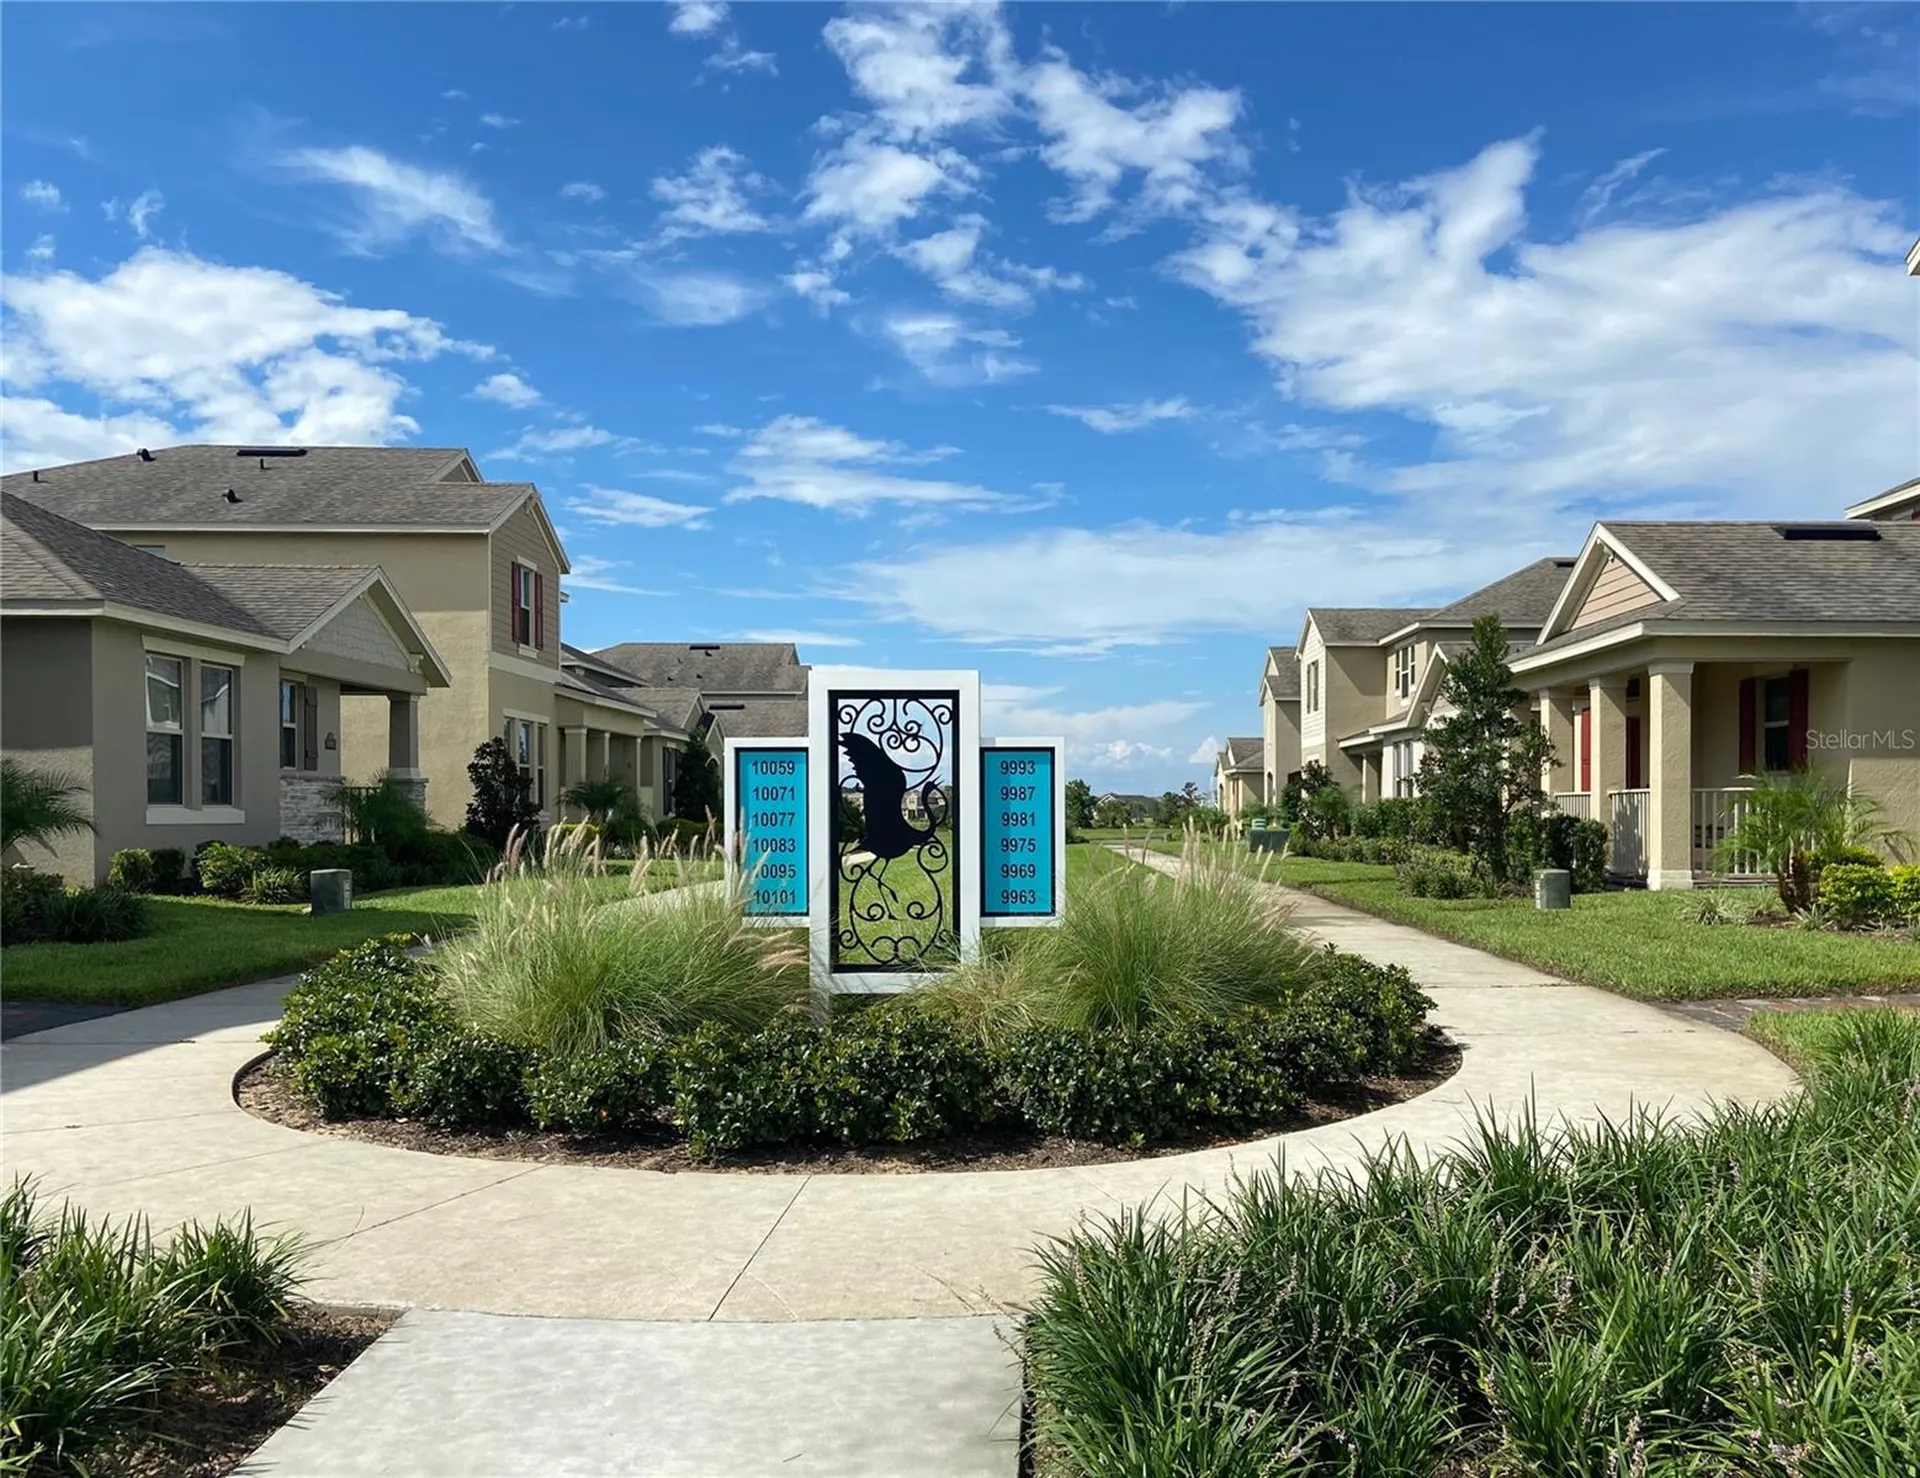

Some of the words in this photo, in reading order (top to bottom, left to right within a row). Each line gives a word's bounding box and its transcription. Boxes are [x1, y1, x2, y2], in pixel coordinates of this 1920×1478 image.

[752, 760, 796, 775] 10059
[1000, 760, 1036, 775] 9993
[752, 786, 796, 801] 10071
[1000, 786, 1036, 801] 9987
[752, 812, 796, 827] 10077
[1001, 812, 1036, 827] 9981
[753, 838, 796, 853] 10083
[1000, 838, 1036, 853] 9975
[1000, 864, 1036, 878] 9969
[753, 889, 796, 905] 10101
[1000, 889, 1037, 905] 9963
